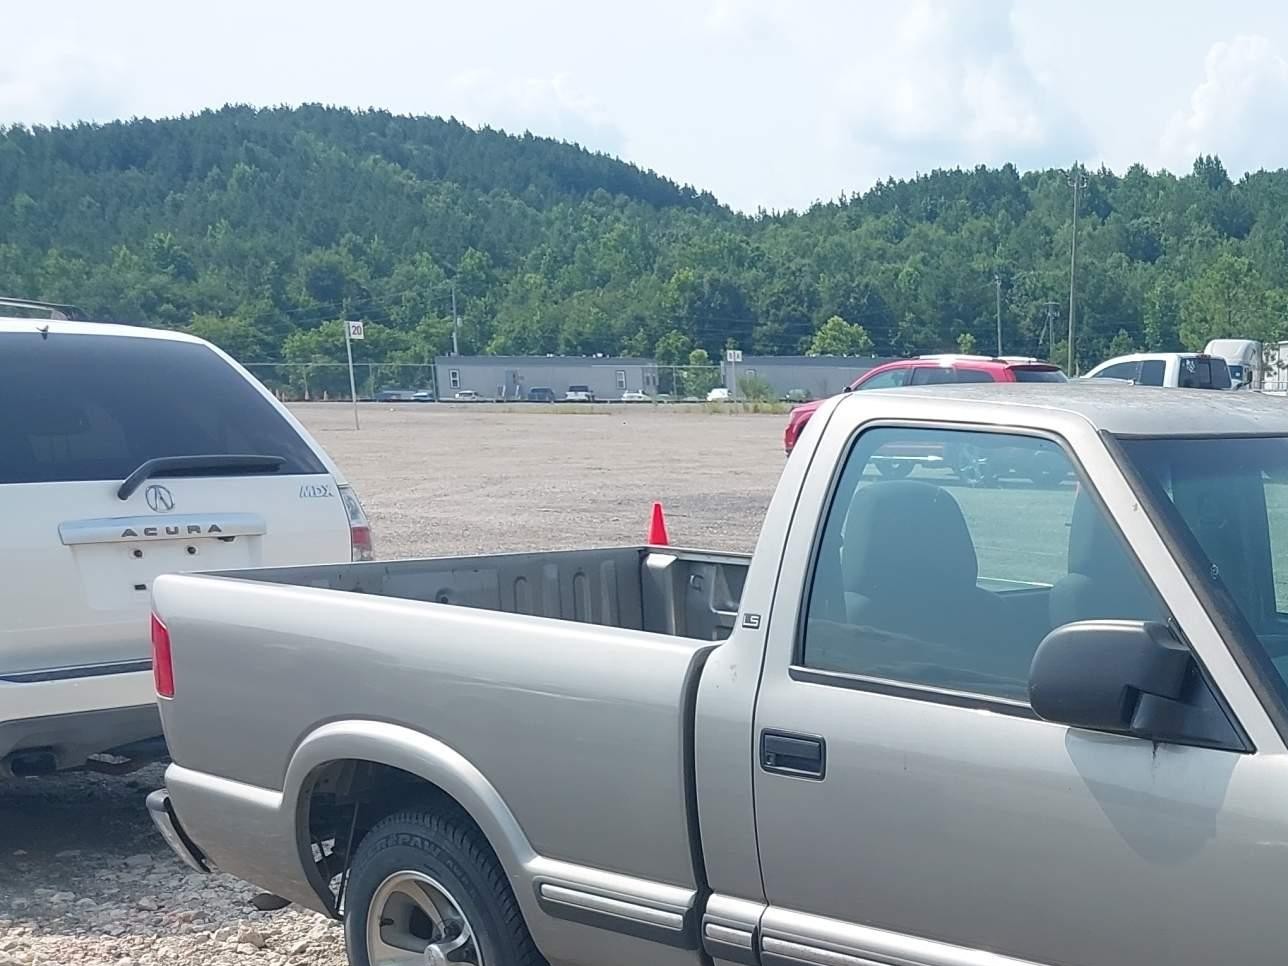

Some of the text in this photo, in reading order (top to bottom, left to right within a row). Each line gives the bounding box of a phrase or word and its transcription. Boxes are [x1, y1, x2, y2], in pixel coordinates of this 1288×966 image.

[352, 324, 362, 335] 20
[299, 484, 335, 498] MDX
[121, 523, 223, 538] ACURA
[742, 615, 760, 627] LS
